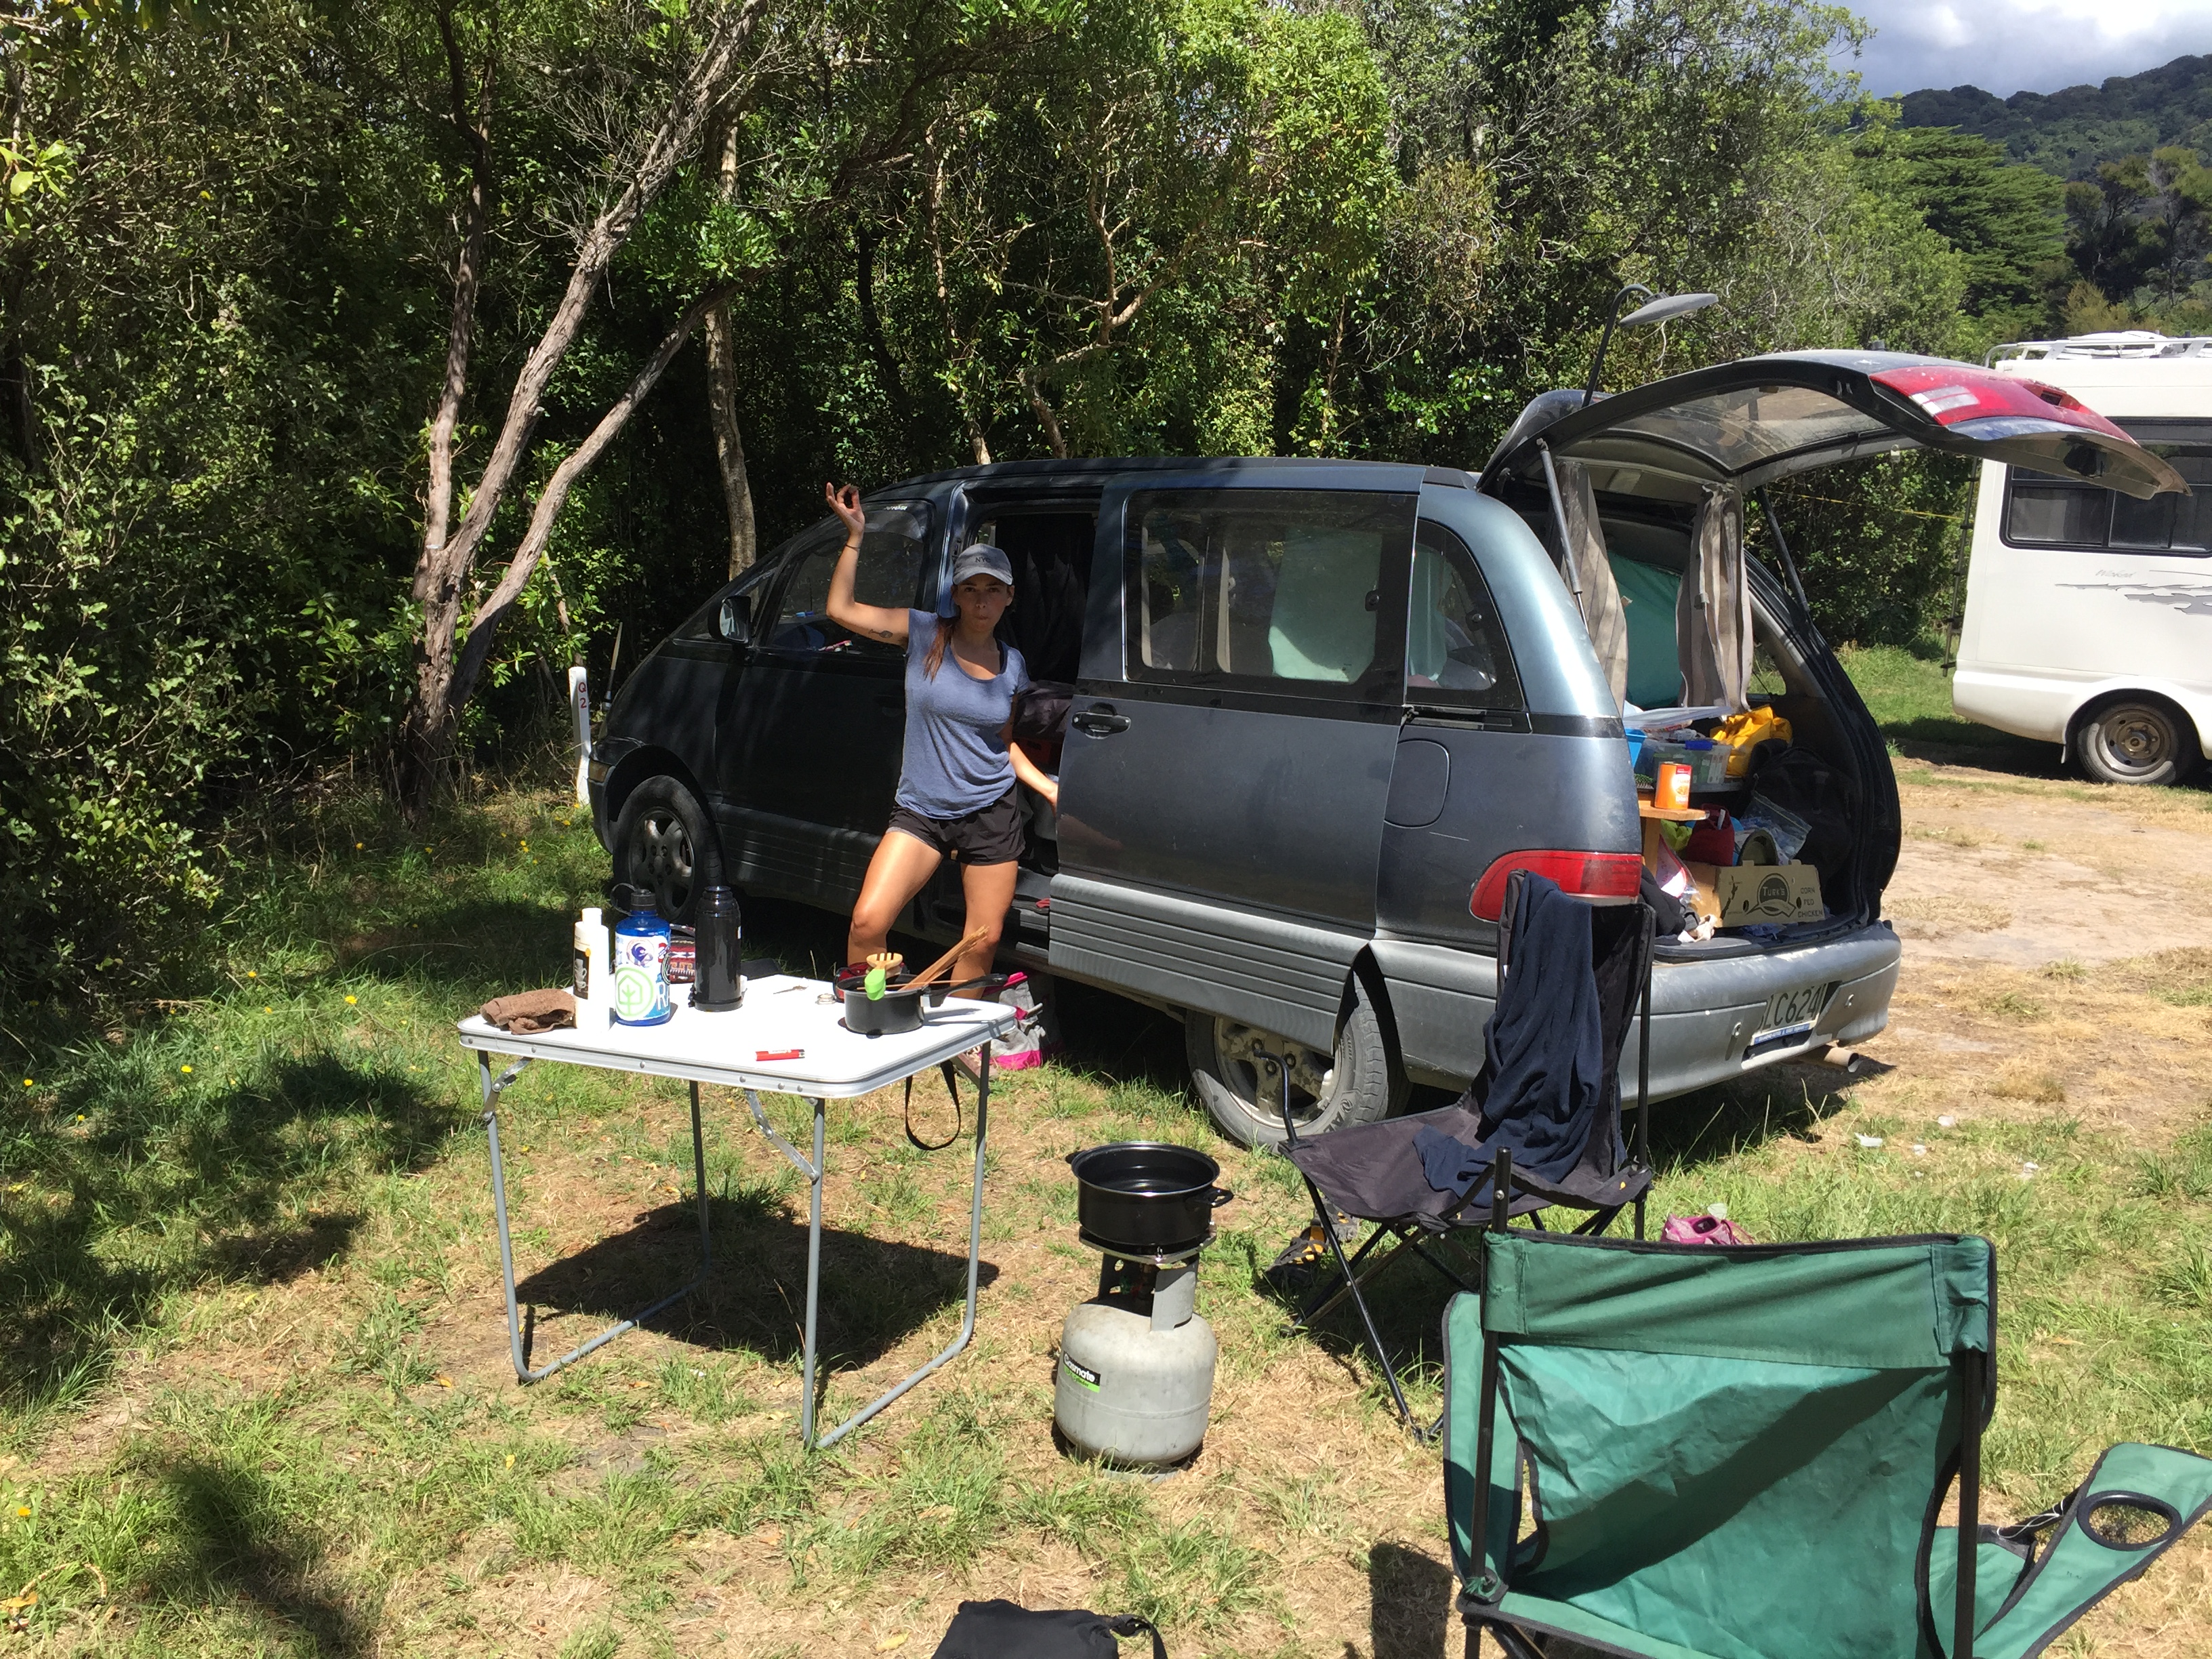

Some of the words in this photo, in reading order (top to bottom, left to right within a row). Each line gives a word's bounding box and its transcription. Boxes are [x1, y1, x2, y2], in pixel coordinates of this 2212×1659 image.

[578, 682, 586, 693] Q
[579, 697, 588, 709] 2
[1800, 886, 1816, 895] CORN
[1797, 909, 1824, 918] CHICKEN
[1757, 985, 1822, 1030] LC624
